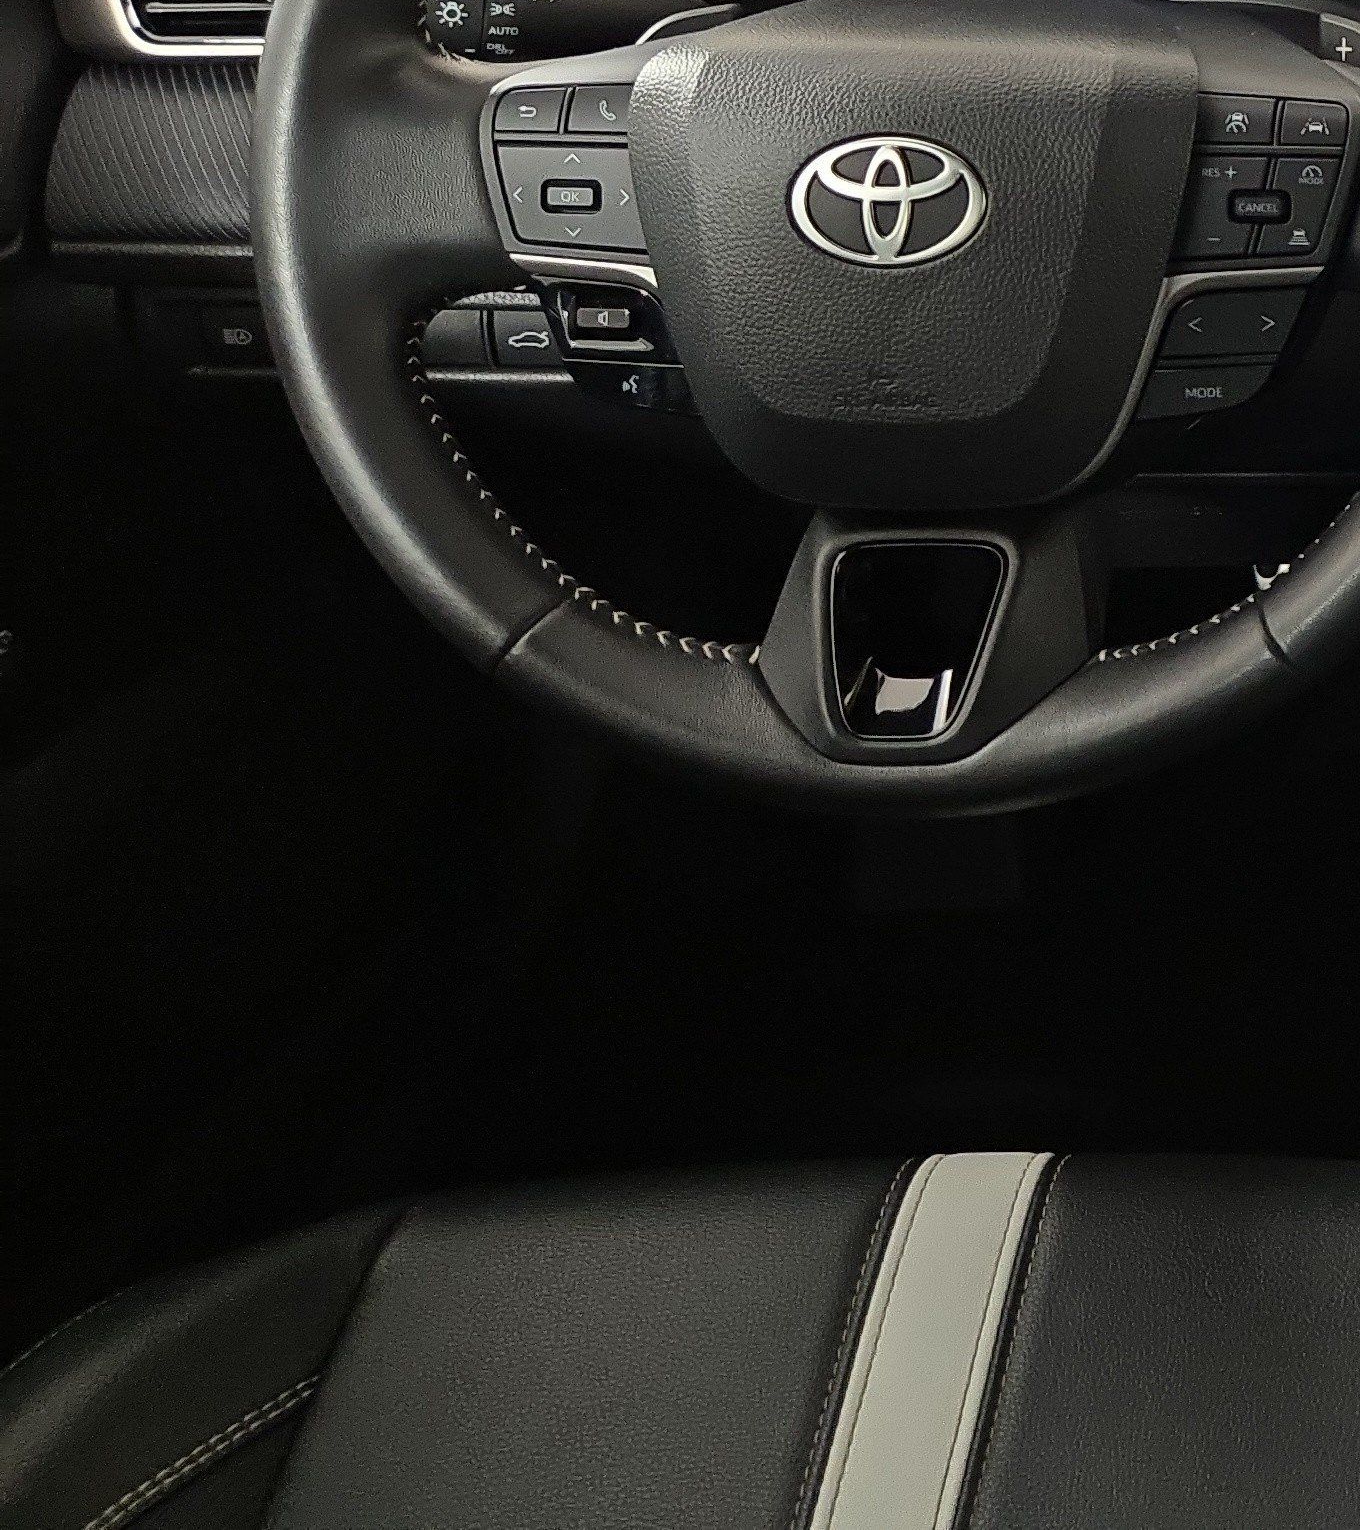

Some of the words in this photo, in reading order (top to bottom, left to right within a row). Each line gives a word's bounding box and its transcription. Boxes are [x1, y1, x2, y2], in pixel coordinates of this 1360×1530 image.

[488, 26, 519, 36] AUTO
[1201, 168, 1220, 177] RES
[560, 190, 580, 204] OK
[1238, 202, 1279, 213] CANCEL
[1185, 386, 1223, 399] MODE
